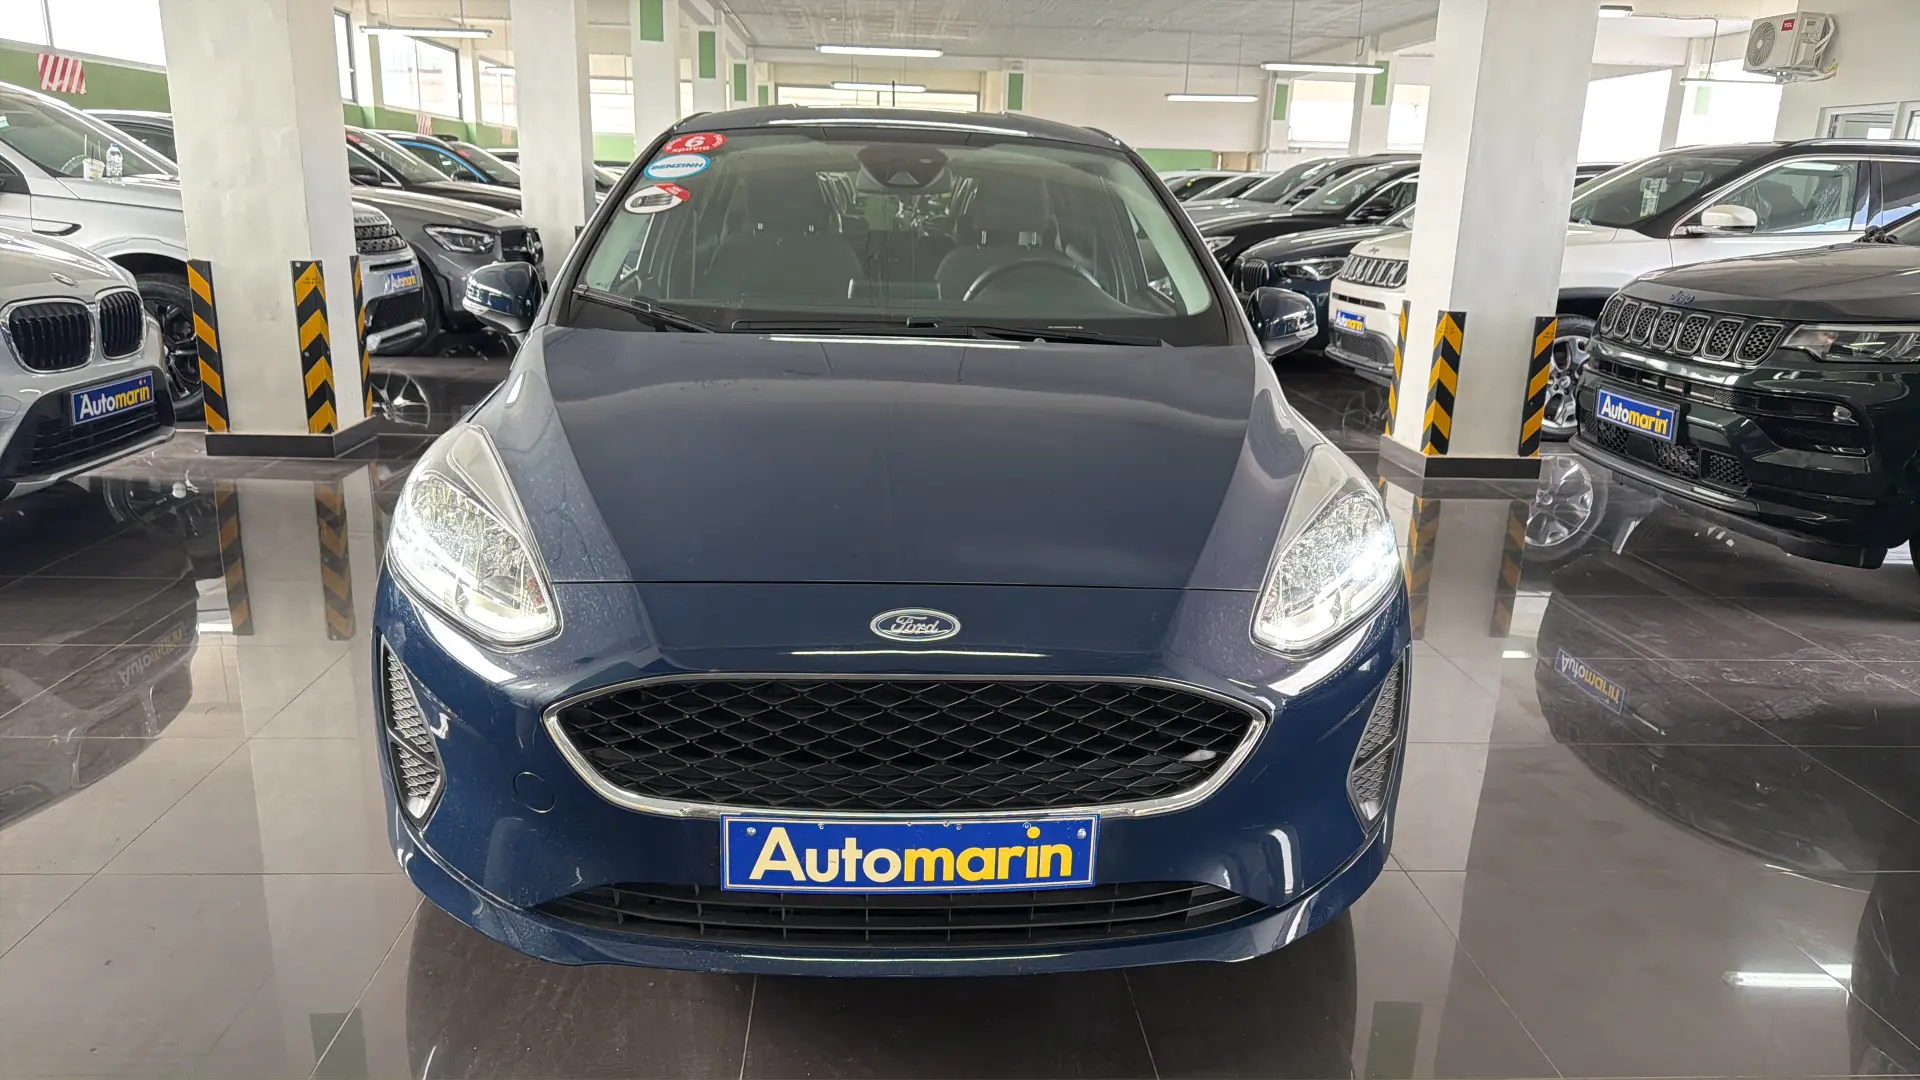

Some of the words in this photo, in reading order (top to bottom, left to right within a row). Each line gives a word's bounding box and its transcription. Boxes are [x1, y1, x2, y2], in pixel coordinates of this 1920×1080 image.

[685, 135, 706, 148] 6
[1669, 291, 1696, 305] Jeep
[80, 380, 150, 419] Automarin
[1601, 395, 1669, 435] Automarin
[890, 615, 940, 635] Ford
[748, 826, 1073, 883] Automarin
